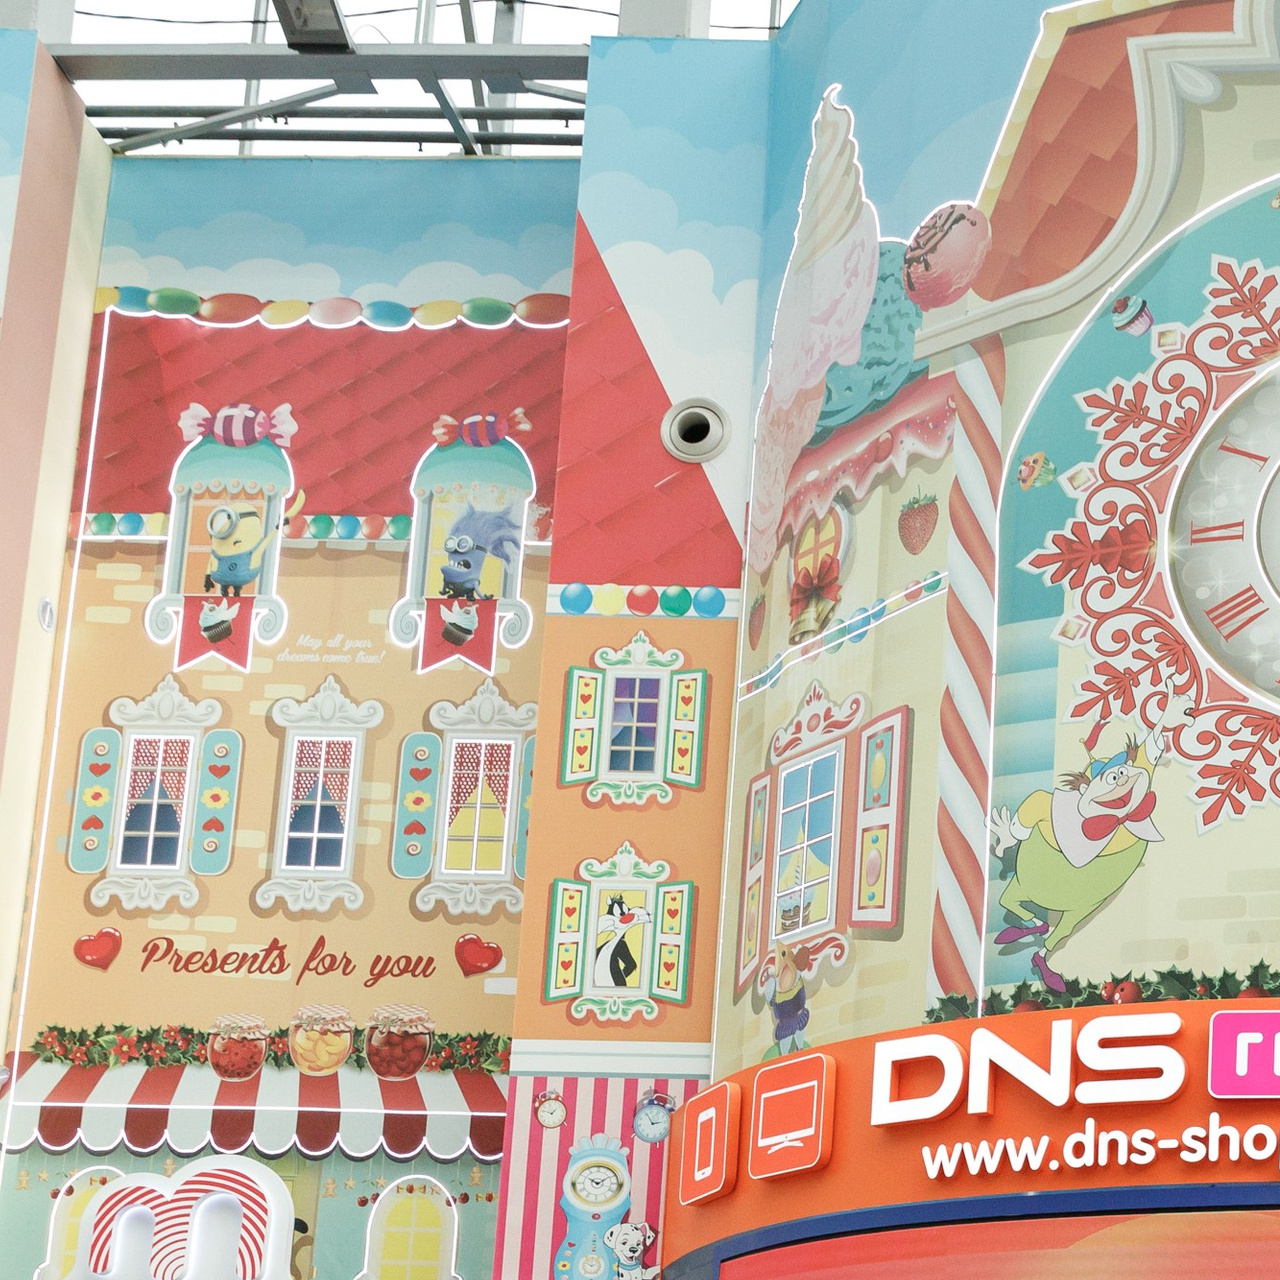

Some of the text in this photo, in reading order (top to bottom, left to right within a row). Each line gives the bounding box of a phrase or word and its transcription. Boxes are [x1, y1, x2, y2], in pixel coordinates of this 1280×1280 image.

[277, 647, 386, 663] dreams come true!
[296, 633, 372, 651] May all your
[140, 935, 436, 988] Presents for you
[870, 1012, 1188, 1128] DNS
